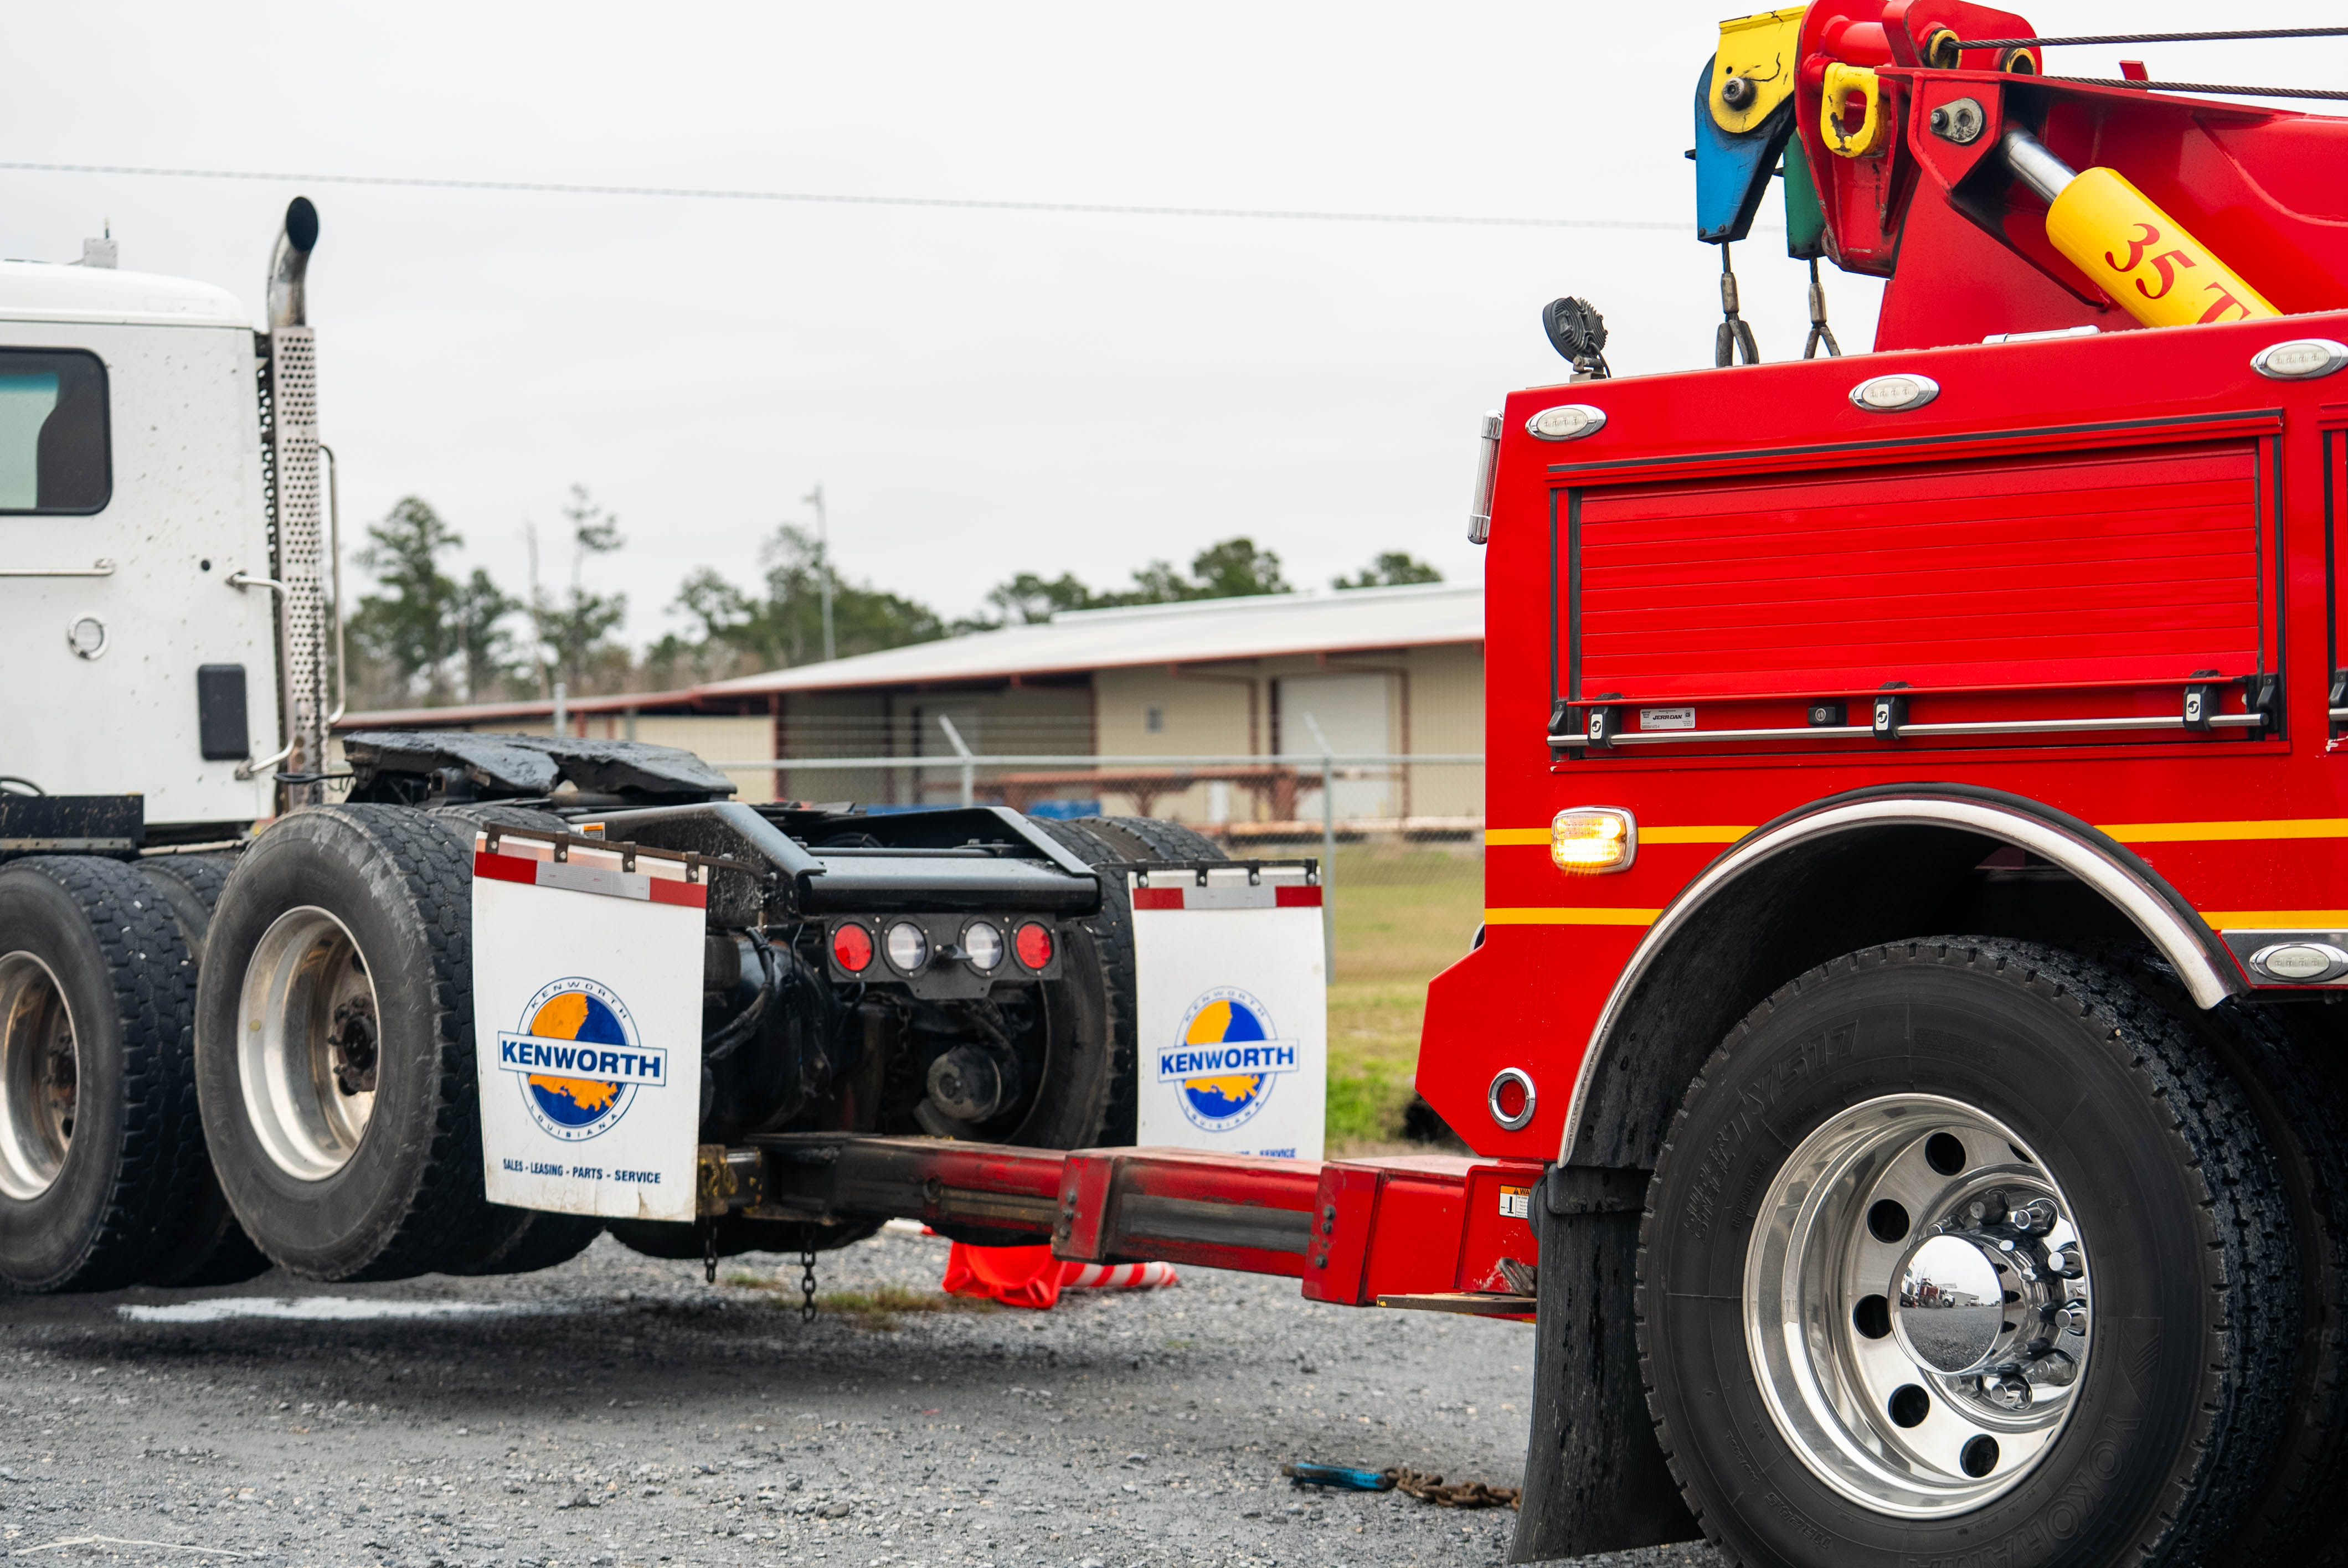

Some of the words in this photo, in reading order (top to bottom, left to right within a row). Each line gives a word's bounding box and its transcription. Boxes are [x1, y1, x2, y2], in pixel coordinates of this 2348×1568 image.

[2105, 223, 2196, 299] 35
[531, 981, 627, 1019] KENWORTH
[502, 1040, 660, 1077] KENWORTH
[1161, 1046, 1294, 1075] KENWORTH
[531, 1103, 617, 1138] LOUISIANA
[503, 1158, 523, 1172] SALES
[531, 1162, 563, 1176] LEASING
[573, 1167, 603, 1179] PARTS
[615, 1170, 661, 1184] SERVICE
[1907, 1415, 2141, 1568] YOKOHA
